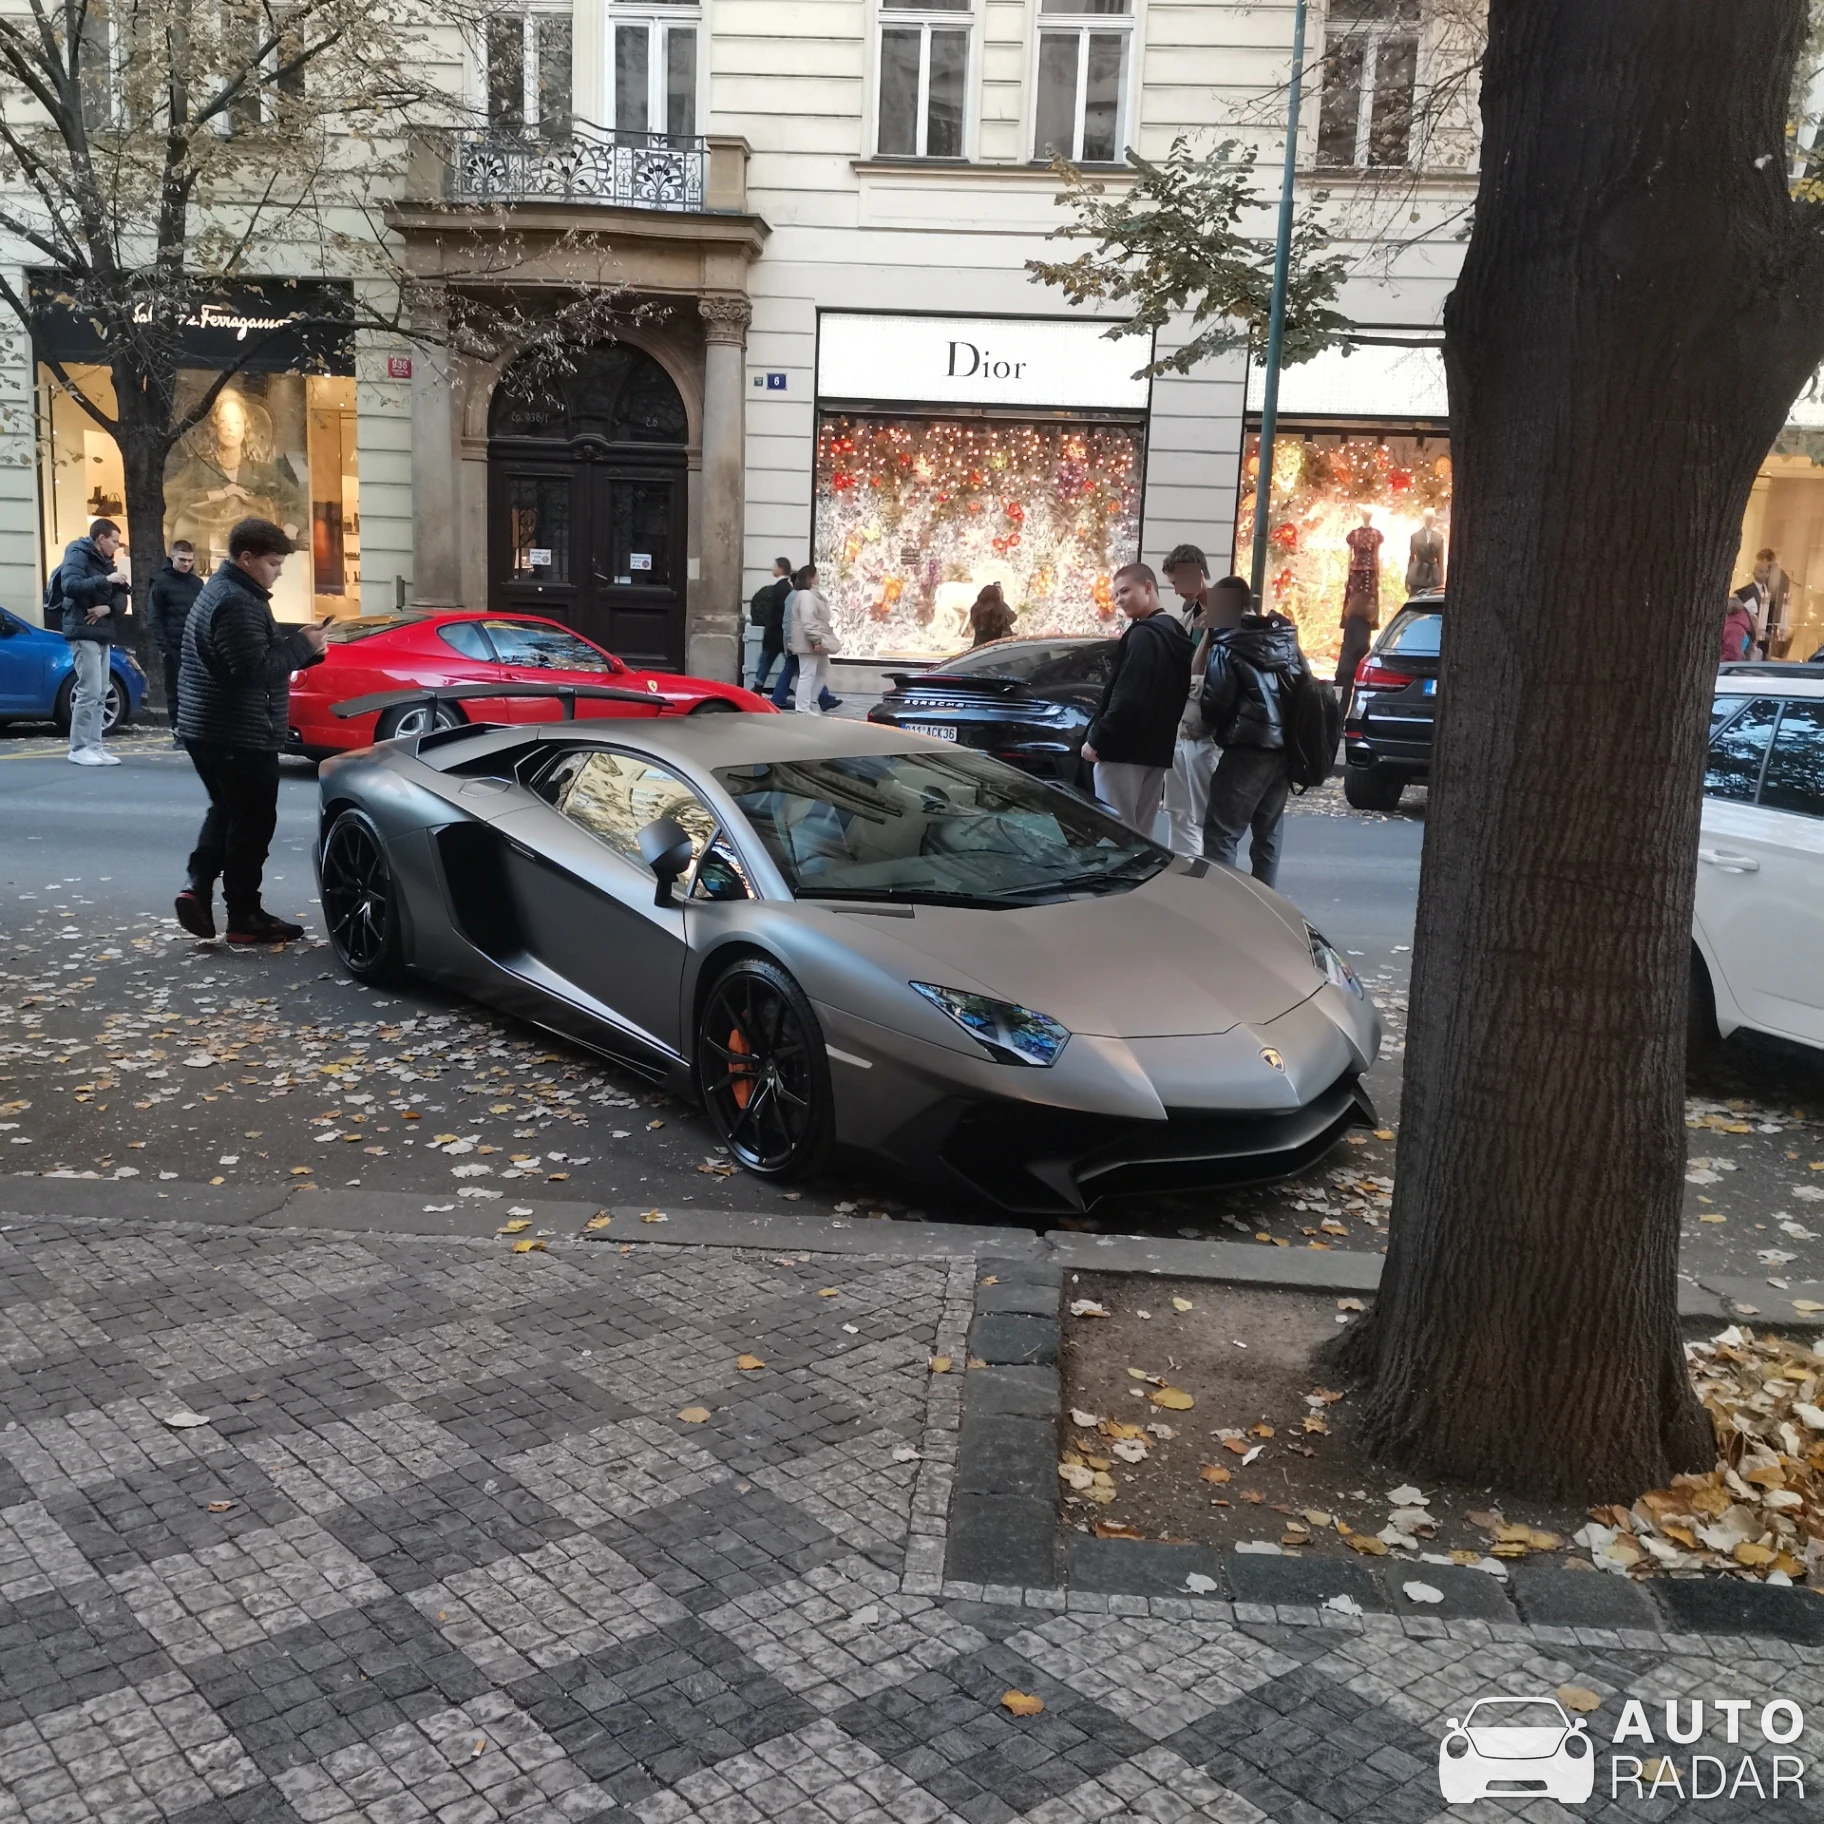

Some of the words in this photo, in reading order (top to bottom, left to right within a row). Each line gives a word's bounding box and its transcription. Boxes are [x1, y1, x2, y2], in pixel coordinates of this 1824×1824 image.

[392, 359, 408, 369] 936
[943, 341, 1027, 379] Dior
[774, 376, 780, 386] 6
[904, 699, 965, 708] PORSCHE
